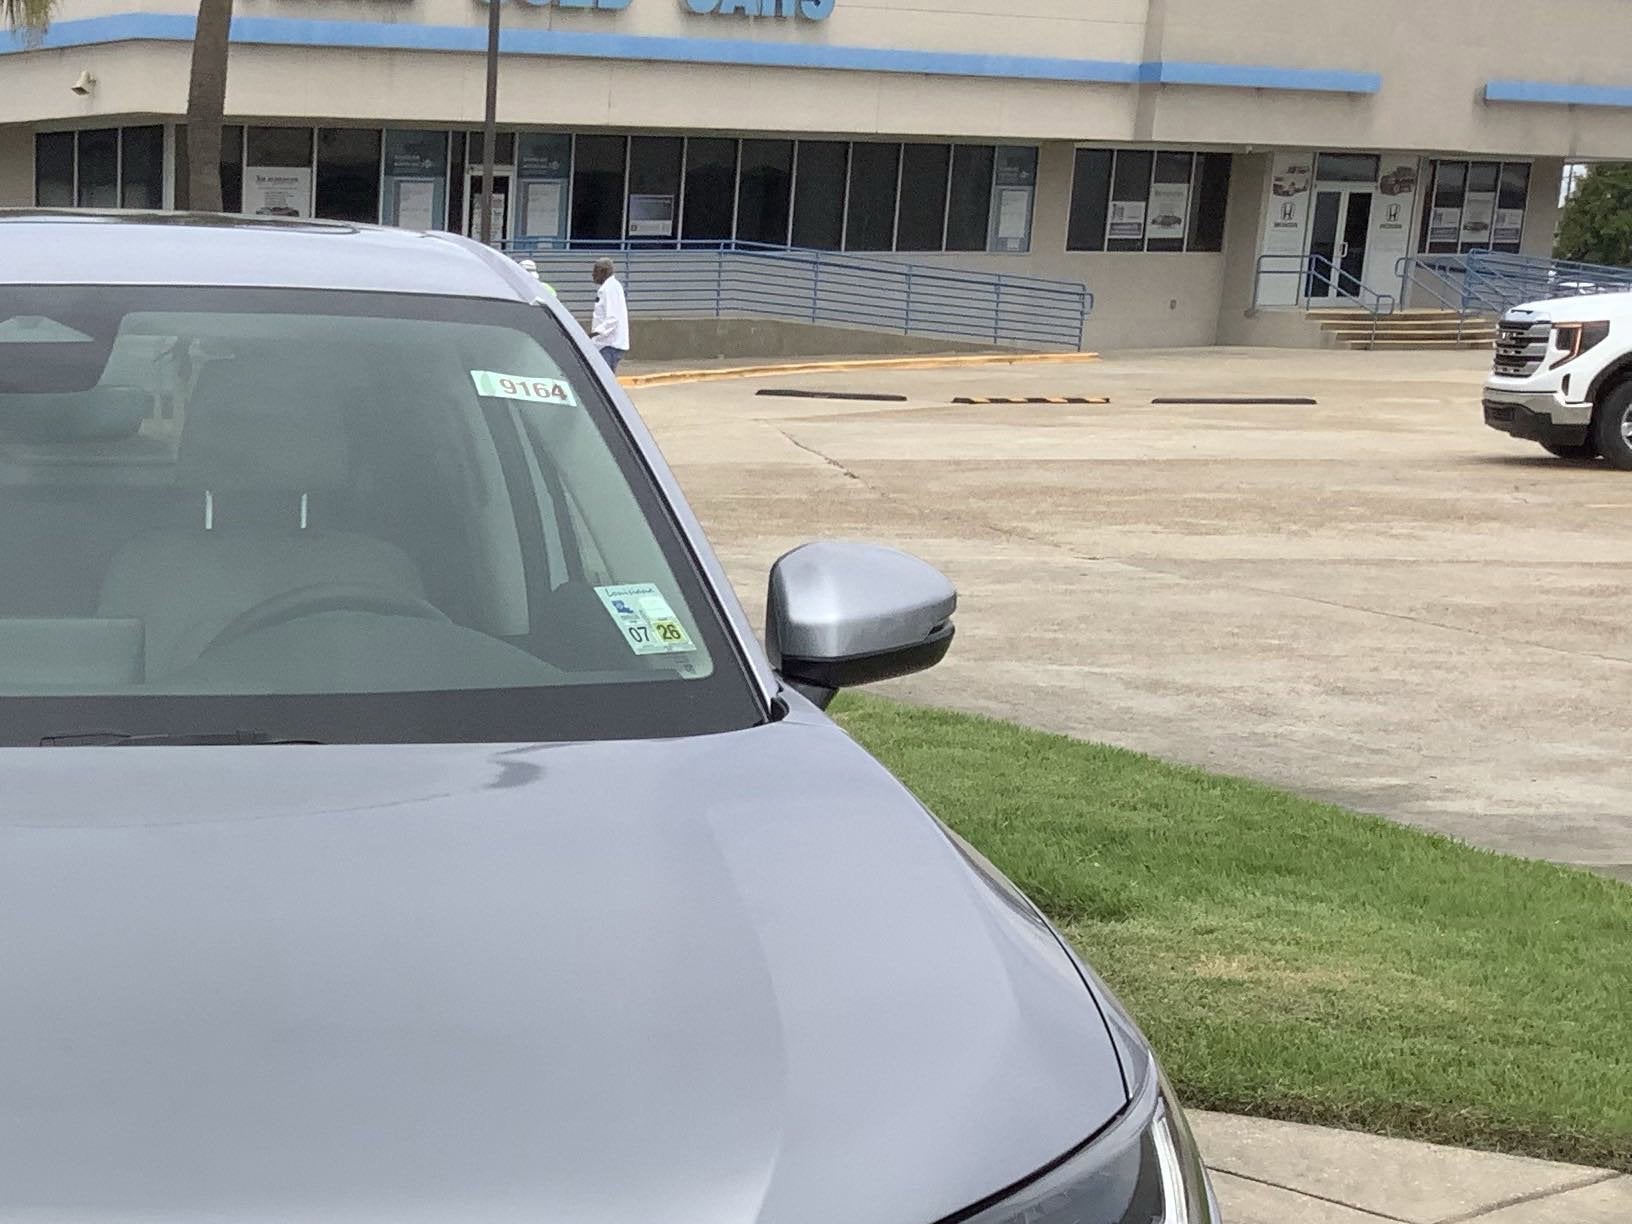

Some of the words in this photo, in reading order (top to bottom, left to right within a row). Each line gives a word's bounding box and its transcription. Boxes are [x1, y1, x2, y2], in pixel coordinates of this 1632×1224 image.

[499, 379, 567, 400] 9164
[628, 626, 650, 643] 07
[656, 624, 681, 640] 26
